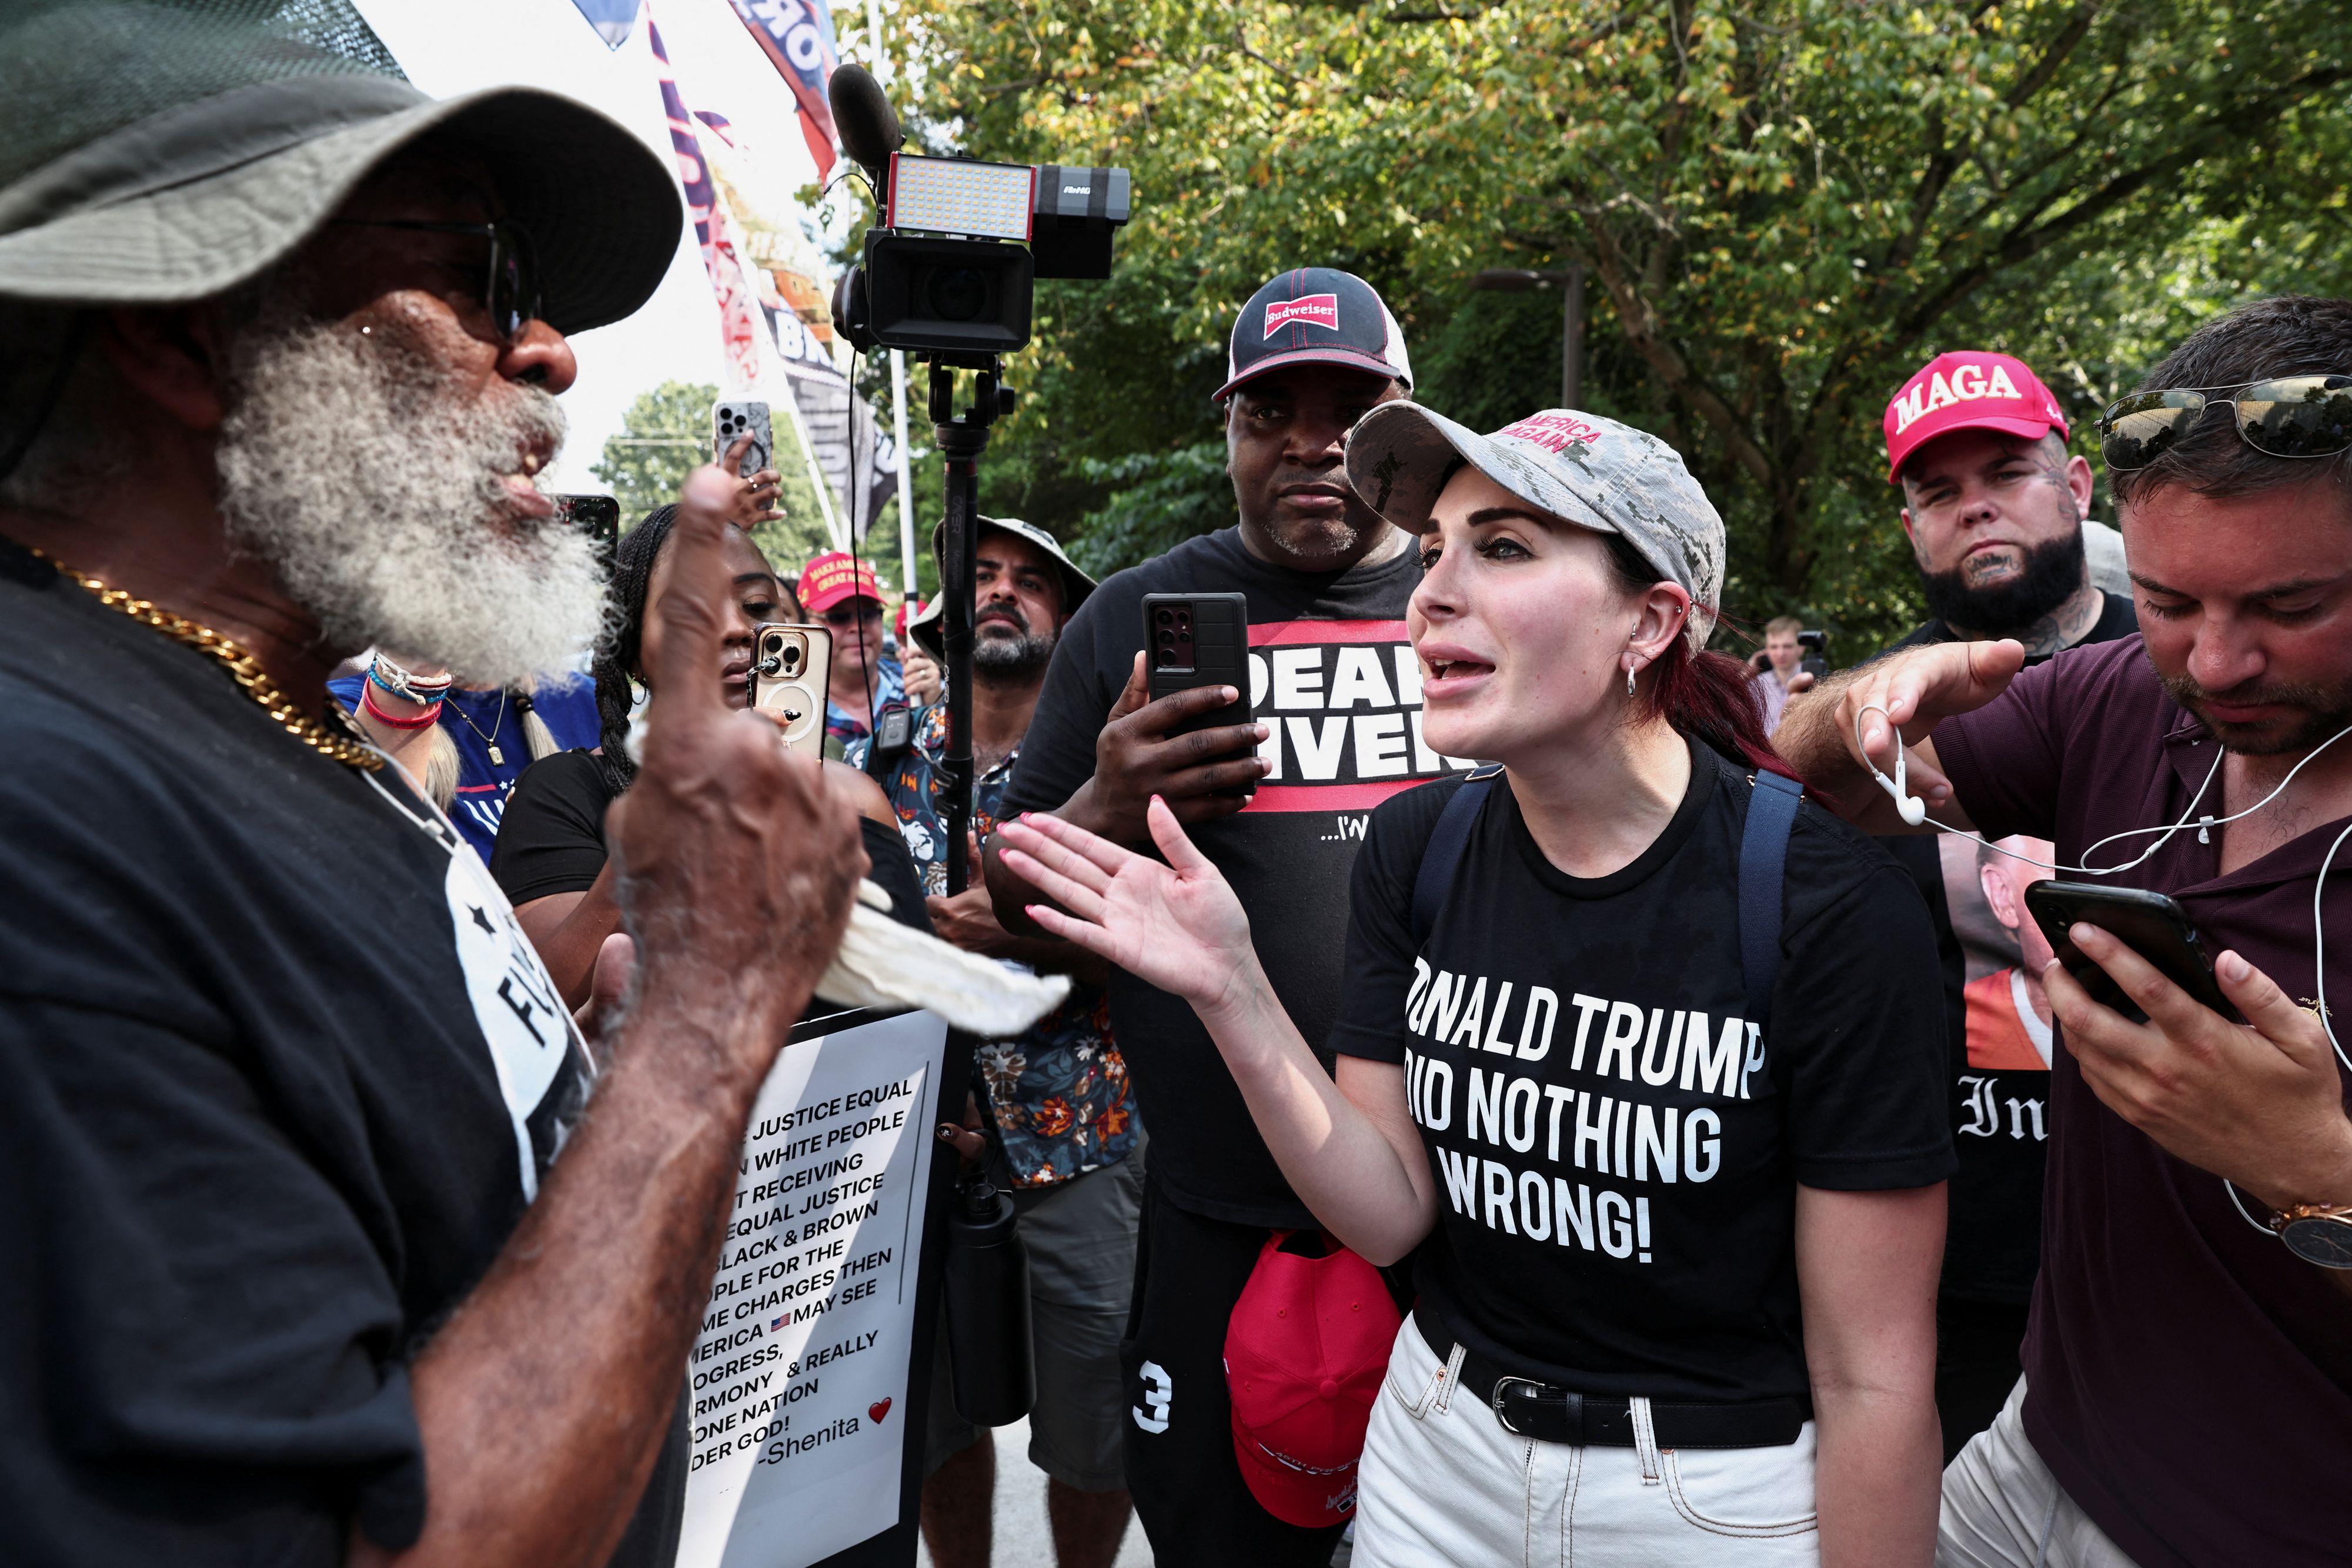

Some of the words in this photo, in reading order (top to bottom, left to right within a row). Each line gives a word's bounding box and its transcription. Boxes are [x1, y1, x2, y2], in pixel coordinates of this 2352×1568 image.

[1267, 303, 1335, 325] Budweiser
[1893, 365, 2022, 436] MAGA
[808, 561, 836, 583] MAKE
[818, 572, 847, 593] GREAT
[1572, 992, 1765, 1099] TRUMP
[752, 1098, 841, 1141] JUSTICE
[845, 1079, 913, 1112] EQUAL
[1467, 1067, 1721, 1184] NOTHING
[755, 1135, 823, 1171] WHITE
[827, 1111, 904, 1148] PEOPLE
[752, 1152, 863, 1204] RECEIVING
[799, 1172, 885, 1215] JUSTICE
[1436, 1145, 1652, 1263] WRONG!
[783, 1230, 798, 1248] &
[803, 1200, 878, 1241] BROWN
[734, 1269, 835, 1320] CHARGES
[840, 1248, 892, 1280] THEN
[758, 1255, 800, 1285] FOR
[805, 1239, 844, 1266] THE
[793, 1293, 838, 1325] MAY
[841, 1278, 877, 1306] SEE
[786, 1362, 801, 1379] &
[806, 1329, 879, 1372] REALLY
[694, 1412, 737, 1444] ONE
[741, 1378, 820, 1423] NATION
[1132, 1359, 1172, 1435] 3
[737, 1415, 790, 1450] GOD!
